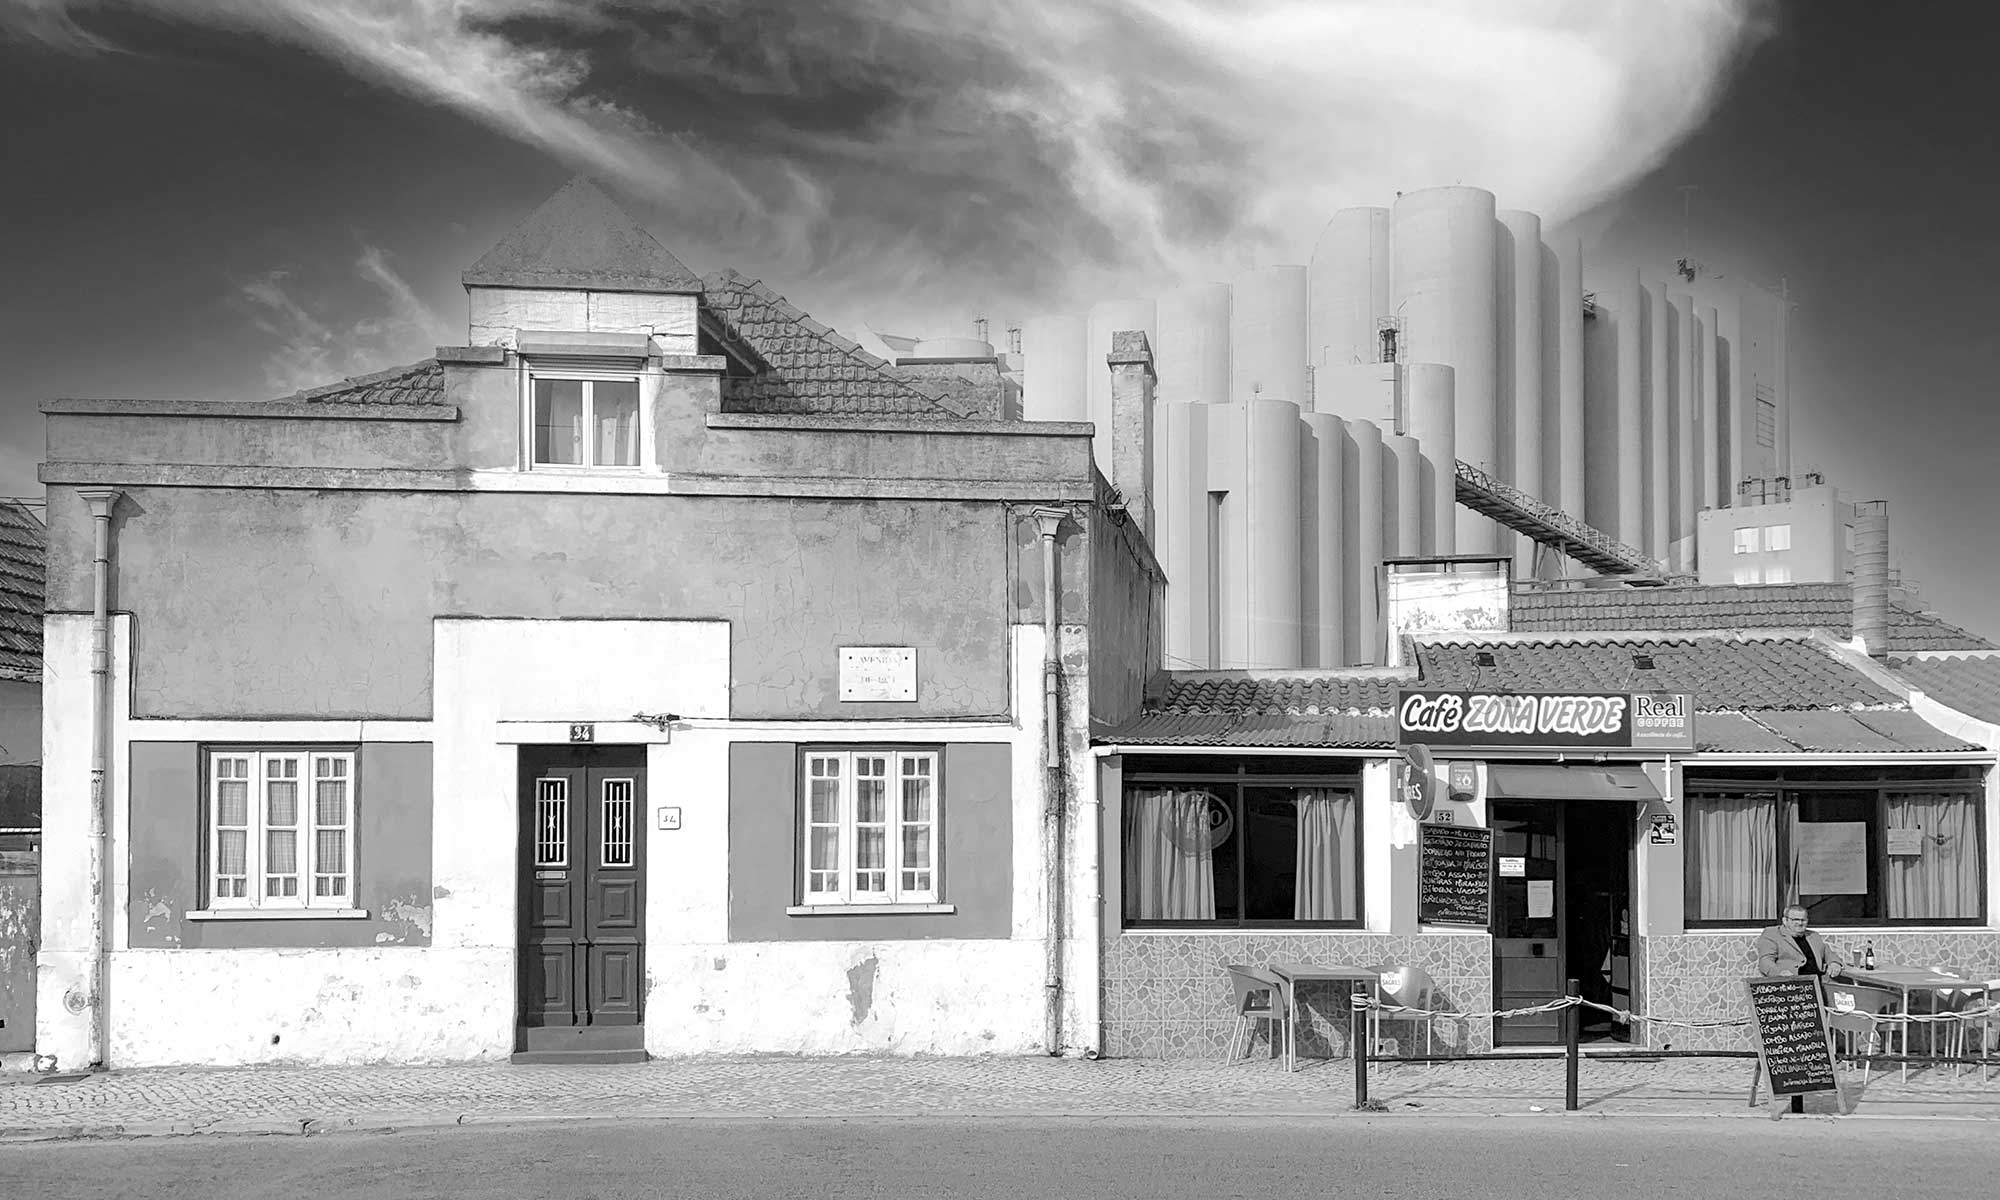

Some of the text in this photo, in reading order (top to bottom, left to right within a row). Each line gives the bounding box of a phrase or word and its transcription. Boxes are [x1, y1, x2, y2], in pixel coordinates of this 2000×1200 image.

[1635, 694, 1686, 718] Real
[1401, 694, 1627, 736] Café ZONA VERDE
[1636, 718, 1685, 728] COFFEE
[1438, 812, 1451, 821] 52
